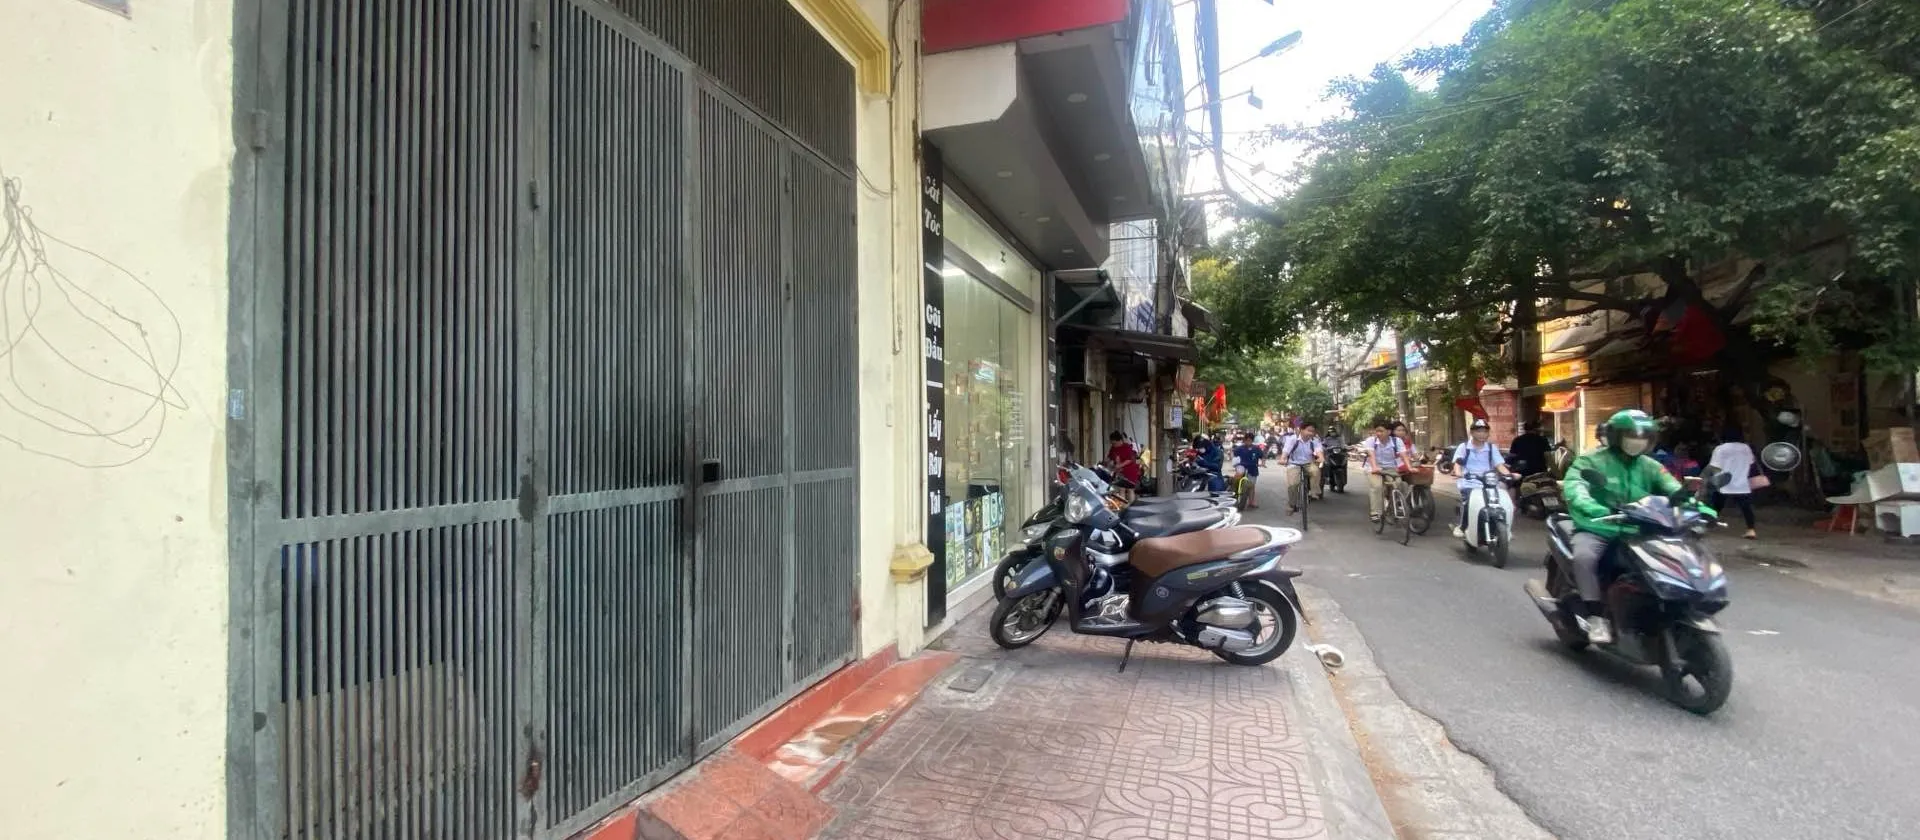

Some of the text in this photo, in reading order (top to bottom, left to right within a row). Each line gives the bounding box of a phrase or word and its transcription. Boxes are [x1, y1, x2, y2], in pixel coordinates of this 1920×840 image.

[925, 208, 940, 236] Tóc
[926, 304, 941, 331] Gội
[925, 335, 943, 361] Đầu
[928, 409, 942, 441] Lấy
[928, 450, 943, 478] Ráy
[930, 490, 941, 515] Tai
